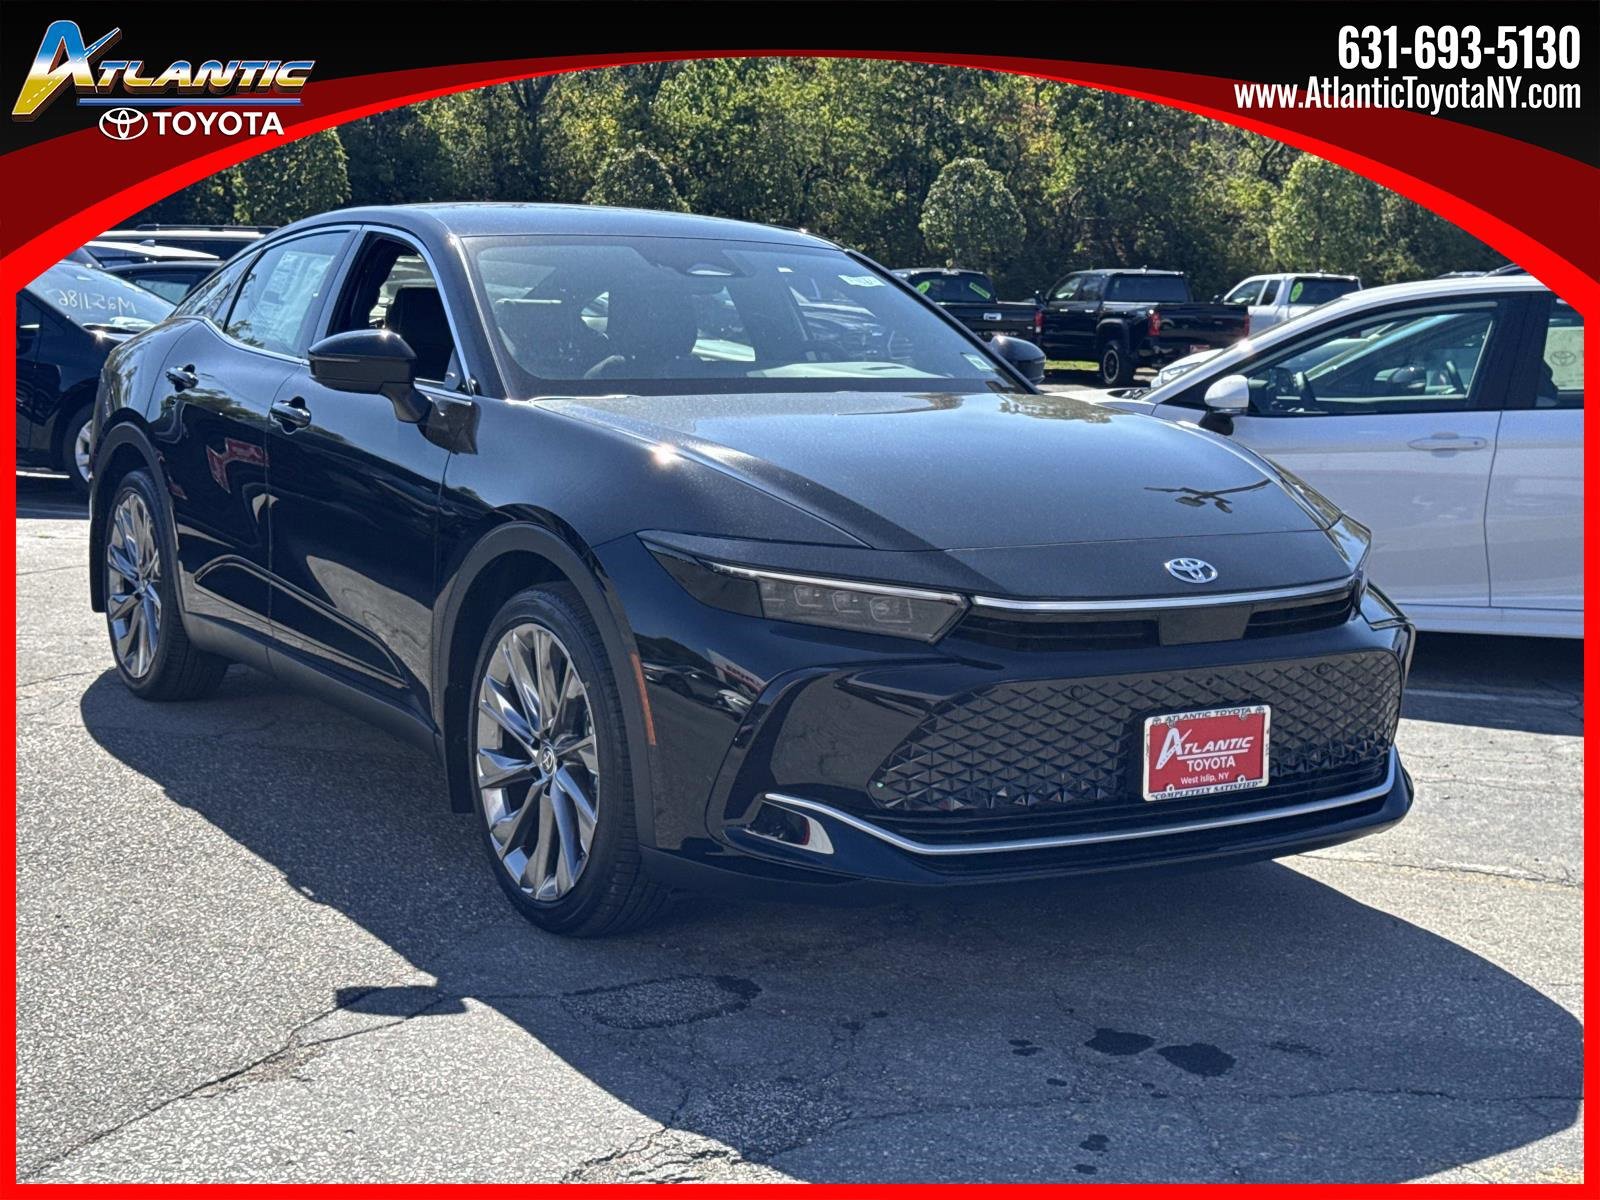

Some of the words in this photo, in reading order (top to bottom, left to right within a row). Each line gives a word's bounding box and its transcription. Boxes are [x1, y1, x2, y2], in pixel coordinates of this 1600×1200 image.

[1165, 711, 1212, 723] ATLANTIC
[1215, 706, 1252, 717] TOYOTA
[1155, 728, 1255, 770] ATLANTIC
[1187, 756, 1236, 773] TOYOTA
[1180, 776, 1199, 786] West
[1218, 772, 1230, 781] NY
